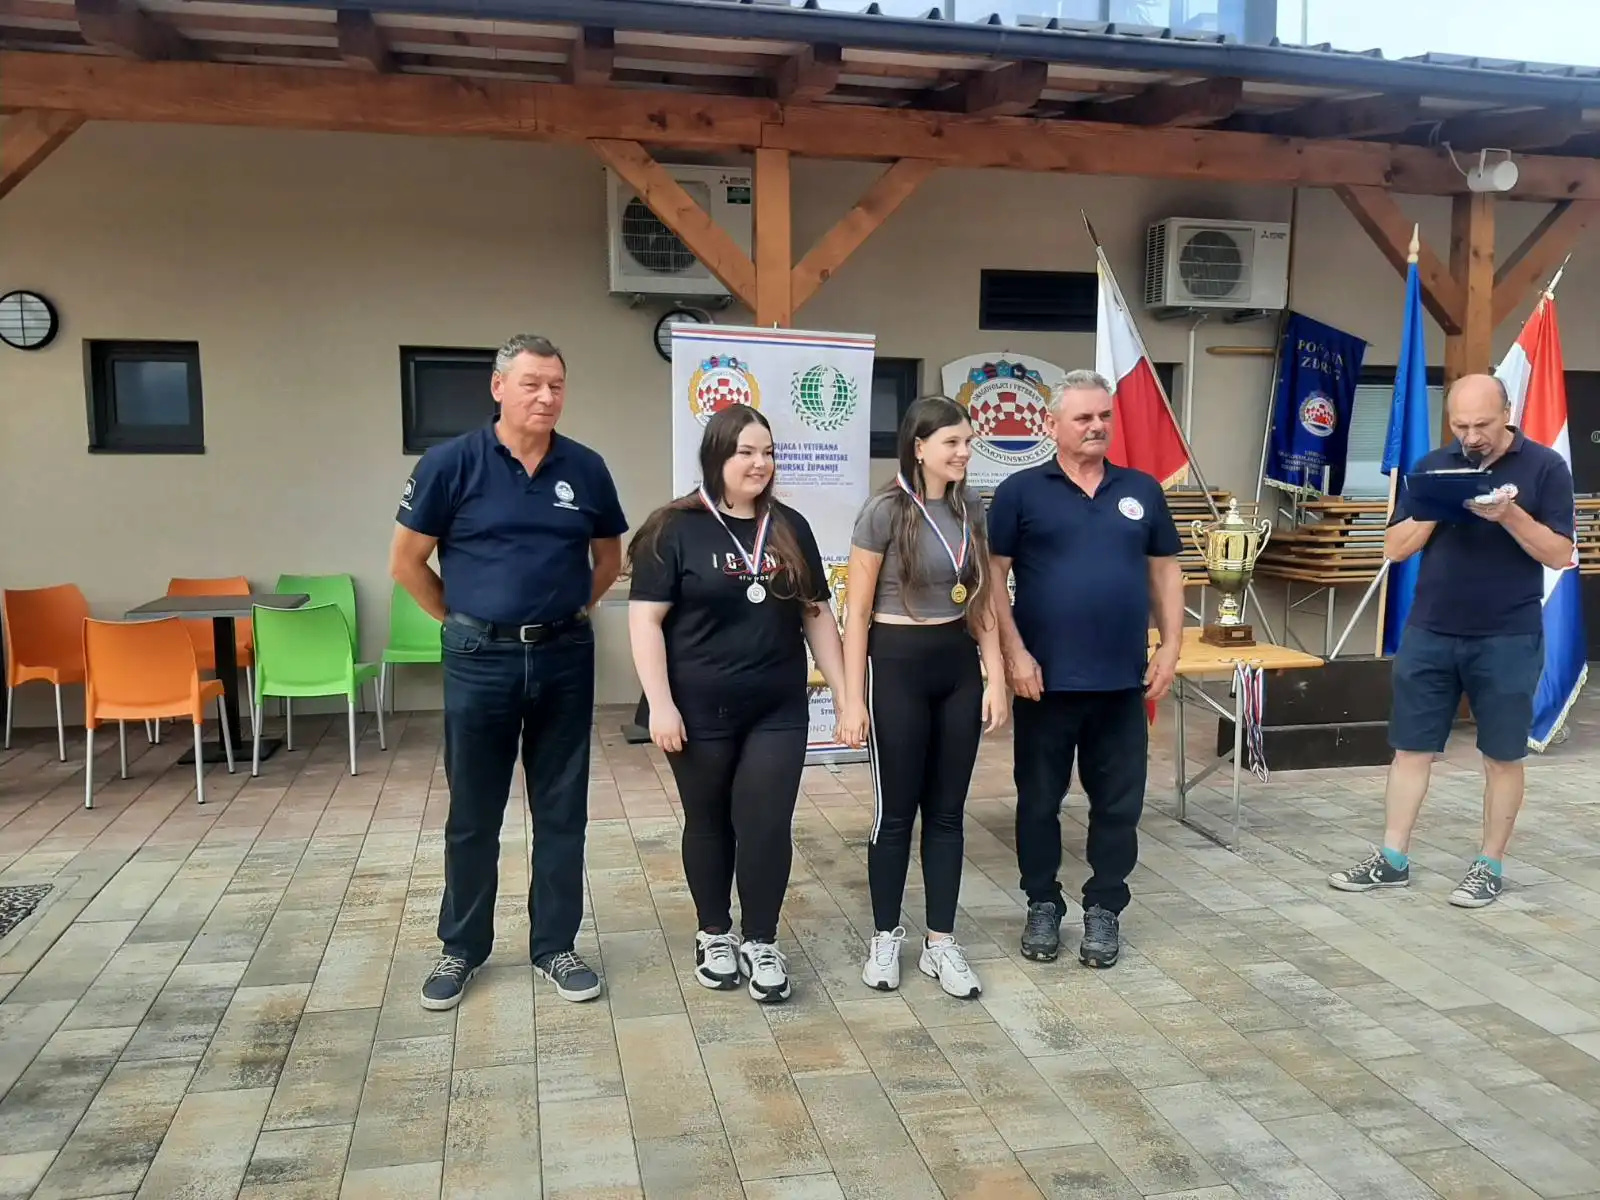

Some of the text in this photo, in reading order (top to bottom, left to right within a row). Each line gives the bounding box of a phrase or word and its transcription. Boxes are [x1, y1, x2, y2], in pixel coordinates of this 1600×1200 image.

[803, 443, 839, 451] VETERANA
[774, 452, 849, 461] REPUBLIKE HRVATSKE
[776, 462, 839, 473] MURSKE ŽUPANIJE
